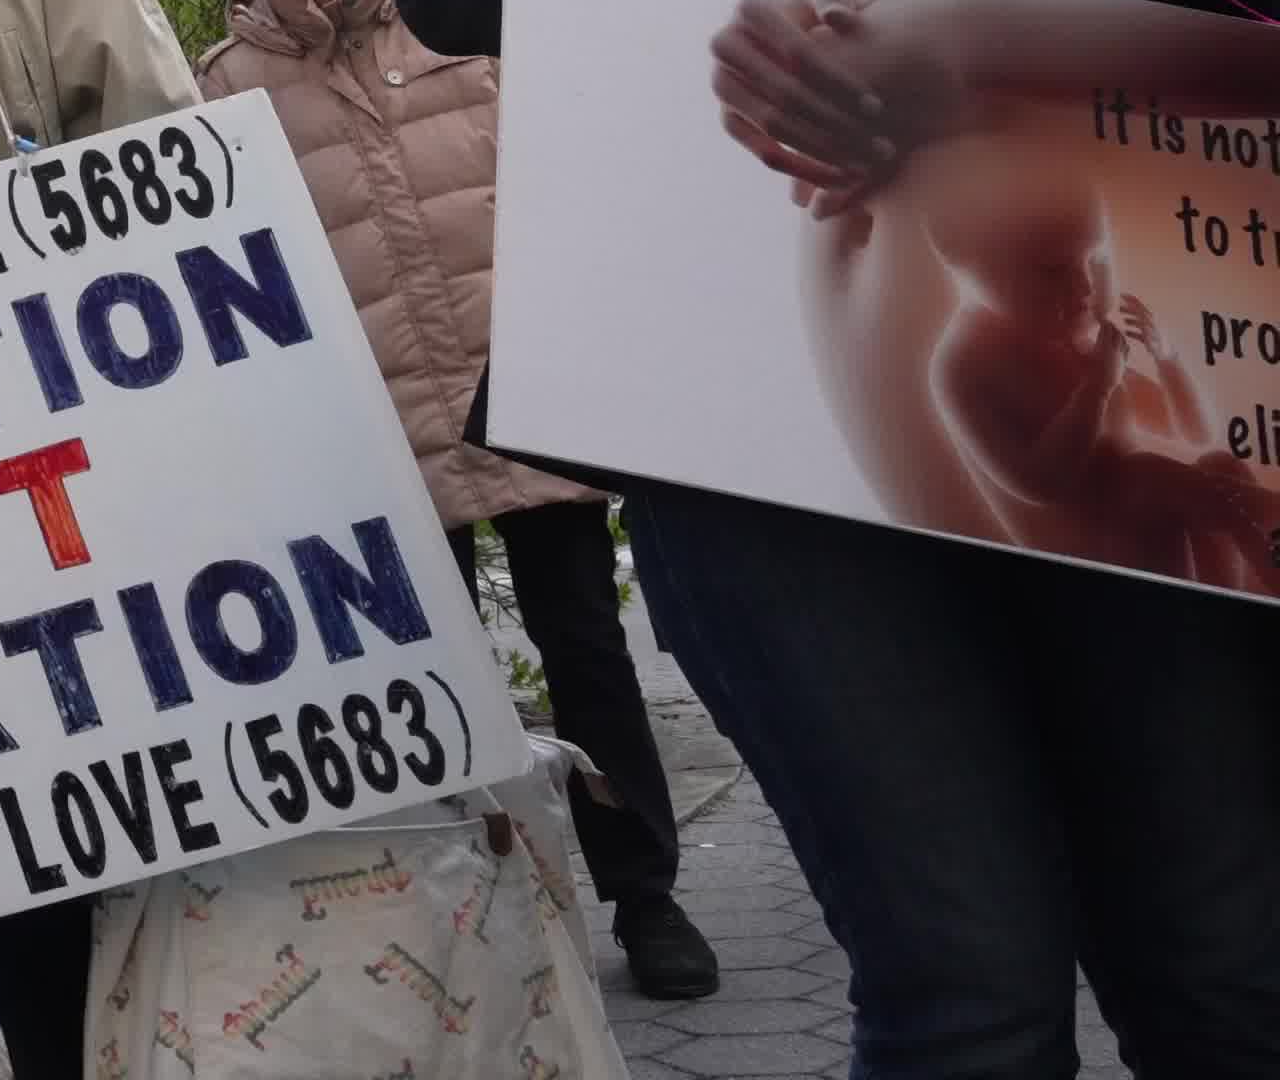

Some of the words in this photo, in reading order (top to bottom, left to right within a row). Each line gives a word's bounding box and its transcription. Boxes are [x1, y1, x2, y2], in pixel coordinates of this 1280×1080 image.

[1094, 87, 1137, 145] it
[1149, 96, 1186, 154] is
[1201, 119, 1280, 177] not
[10, 115, 235, 259] (5683)
[1175, 195, 1229, 257] to
[1242, 208, 1280, 268] t
[1201, 311, 1280, 366] pro
[223, 670, 472, 828] (5683)
